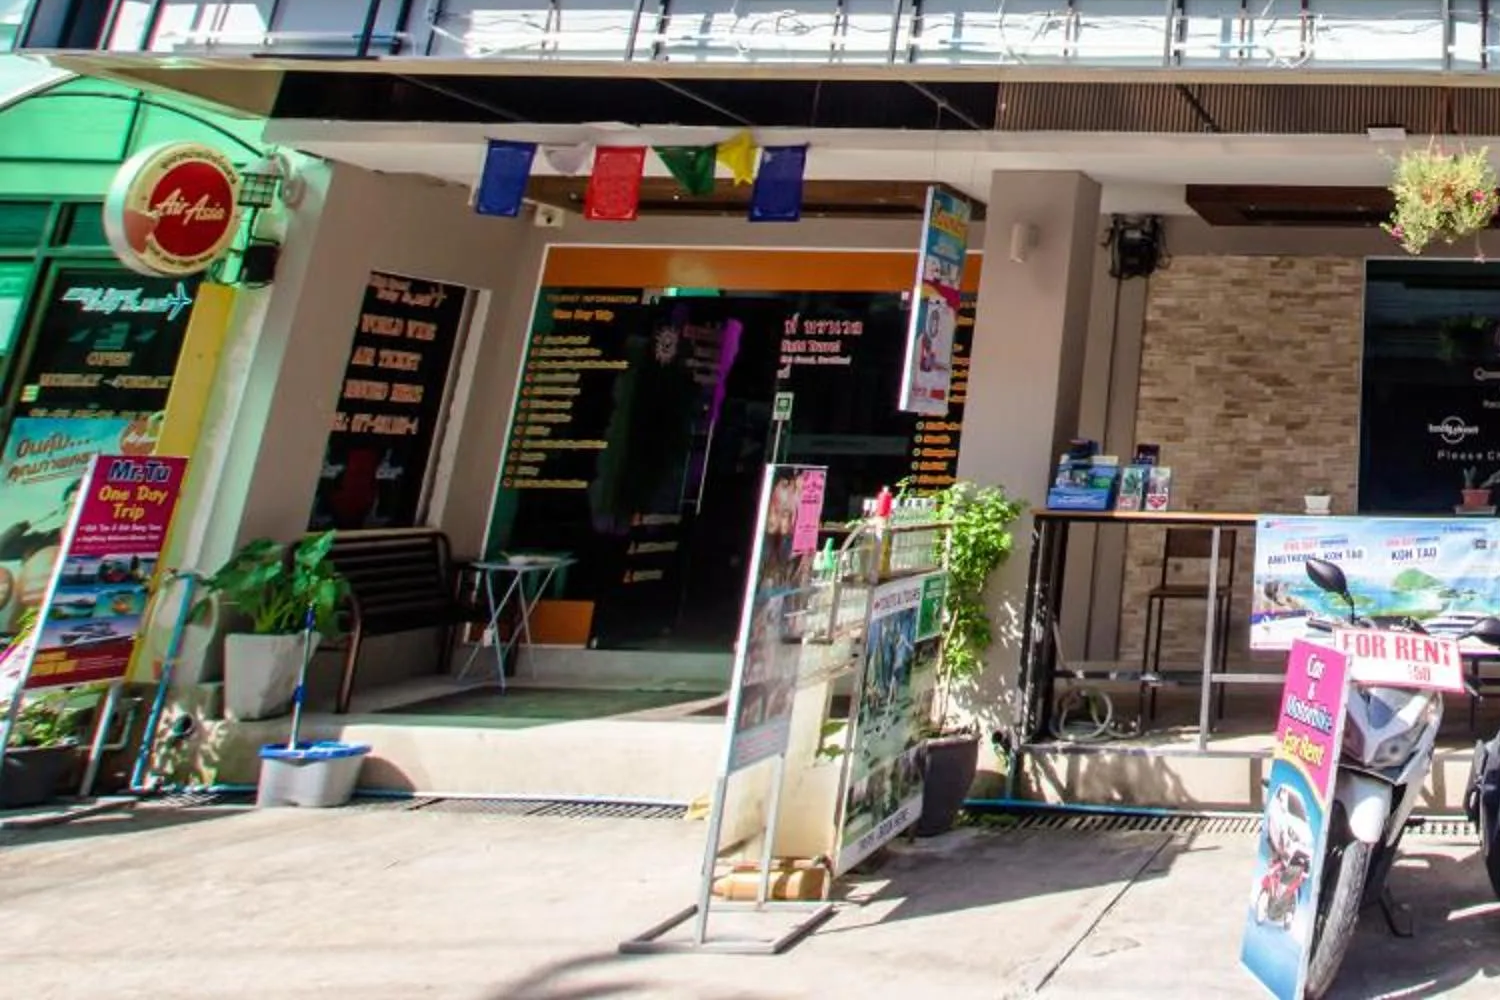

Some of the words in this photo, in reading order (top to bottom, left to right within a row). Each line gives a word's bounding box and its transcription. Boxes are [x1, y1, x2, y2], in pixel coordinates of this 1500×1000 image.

[98, 485, 129, 502] One
[136, 485, 169, 505] Day
[112, 503, 145, 521] Trip
[1343, 633, 1386, 659] FOR
[1395, 636, 1451, 666] RENT
